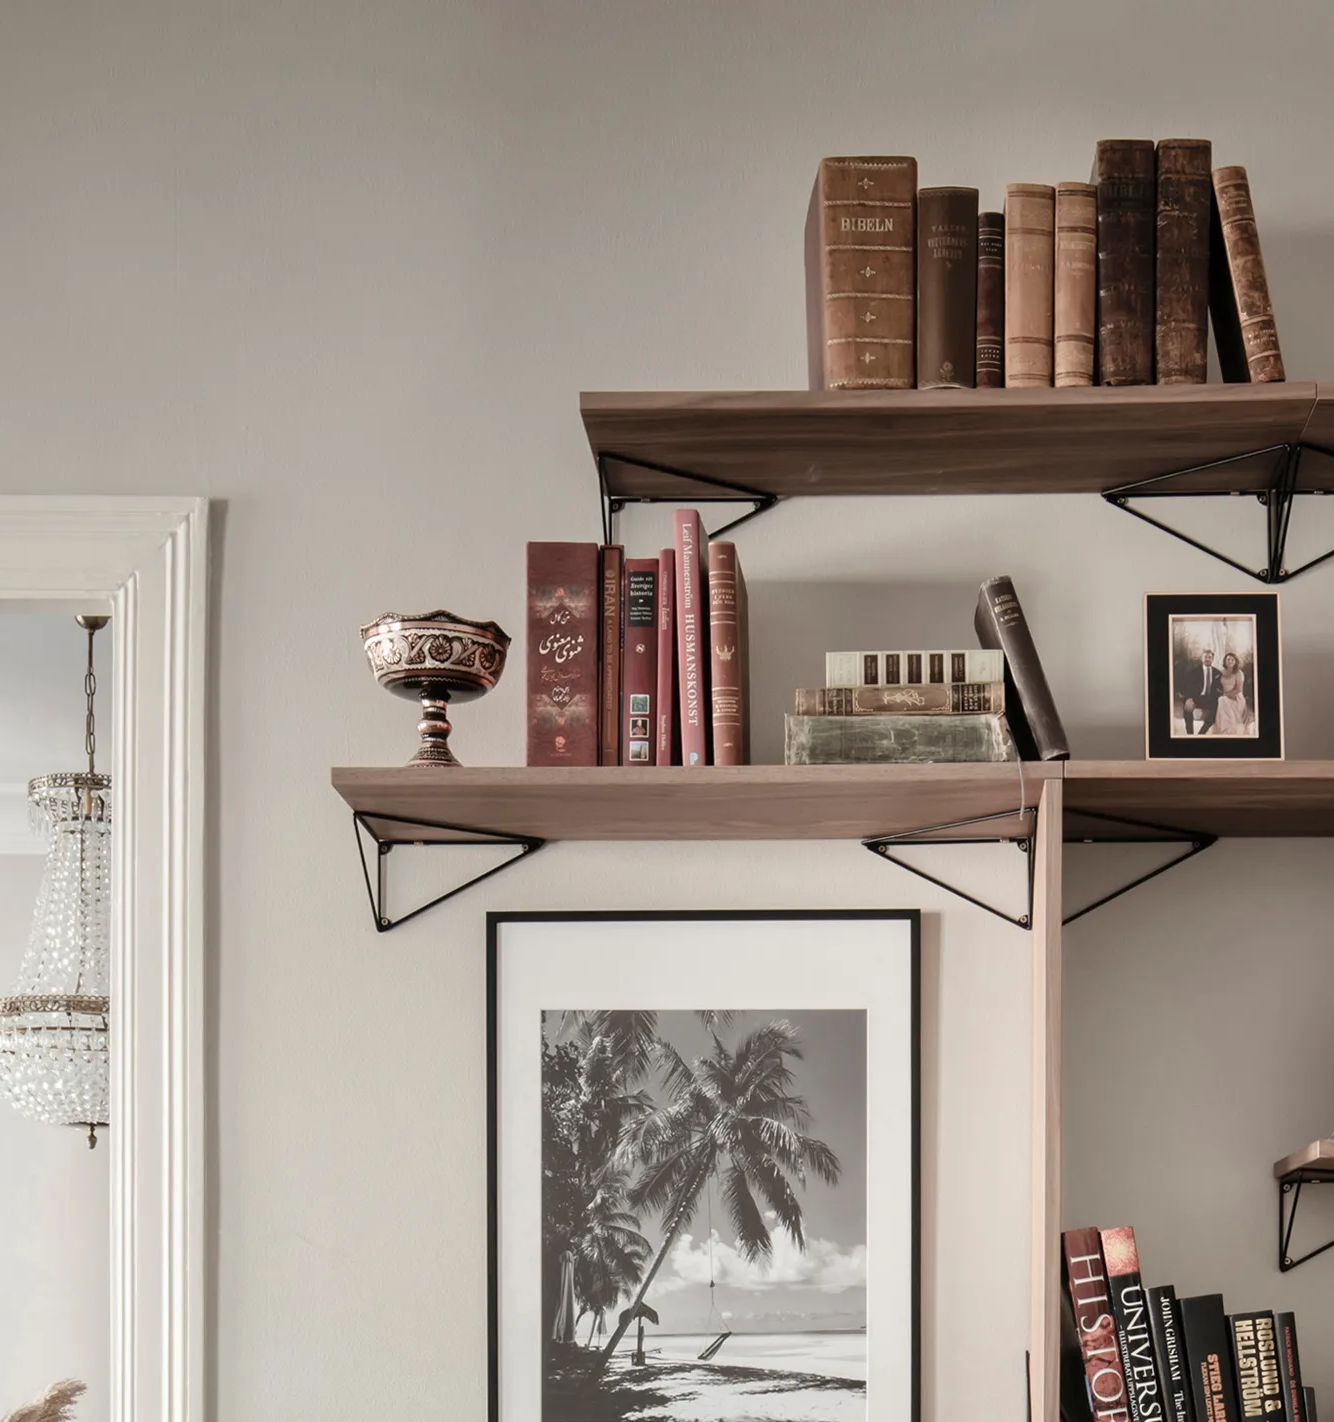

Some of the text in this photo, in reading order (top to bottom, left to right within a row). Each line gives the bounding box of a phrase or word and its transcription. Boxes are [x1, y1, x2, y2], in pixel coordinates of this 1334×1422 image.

[841, 217, 894, 232] BIBELN
[605, 579, 616, 617] IRAN
[682, 523, 699, 726] Leif Mannerström HUSMANSKONST
[606, 644, 613, 654] TO
[1161, 1296, 1174, 1327] JOHN
[1166, 1327, 1182, 1381] GRISHAM
[1207, 1353, 1223, 1392] STIEG
[1235, 1319, 1264, 1418] HELLSTRÖM
[1255, 1317, 1283, 1413] ROSLUND &
[1173, 1390, 1184, 1410] The
